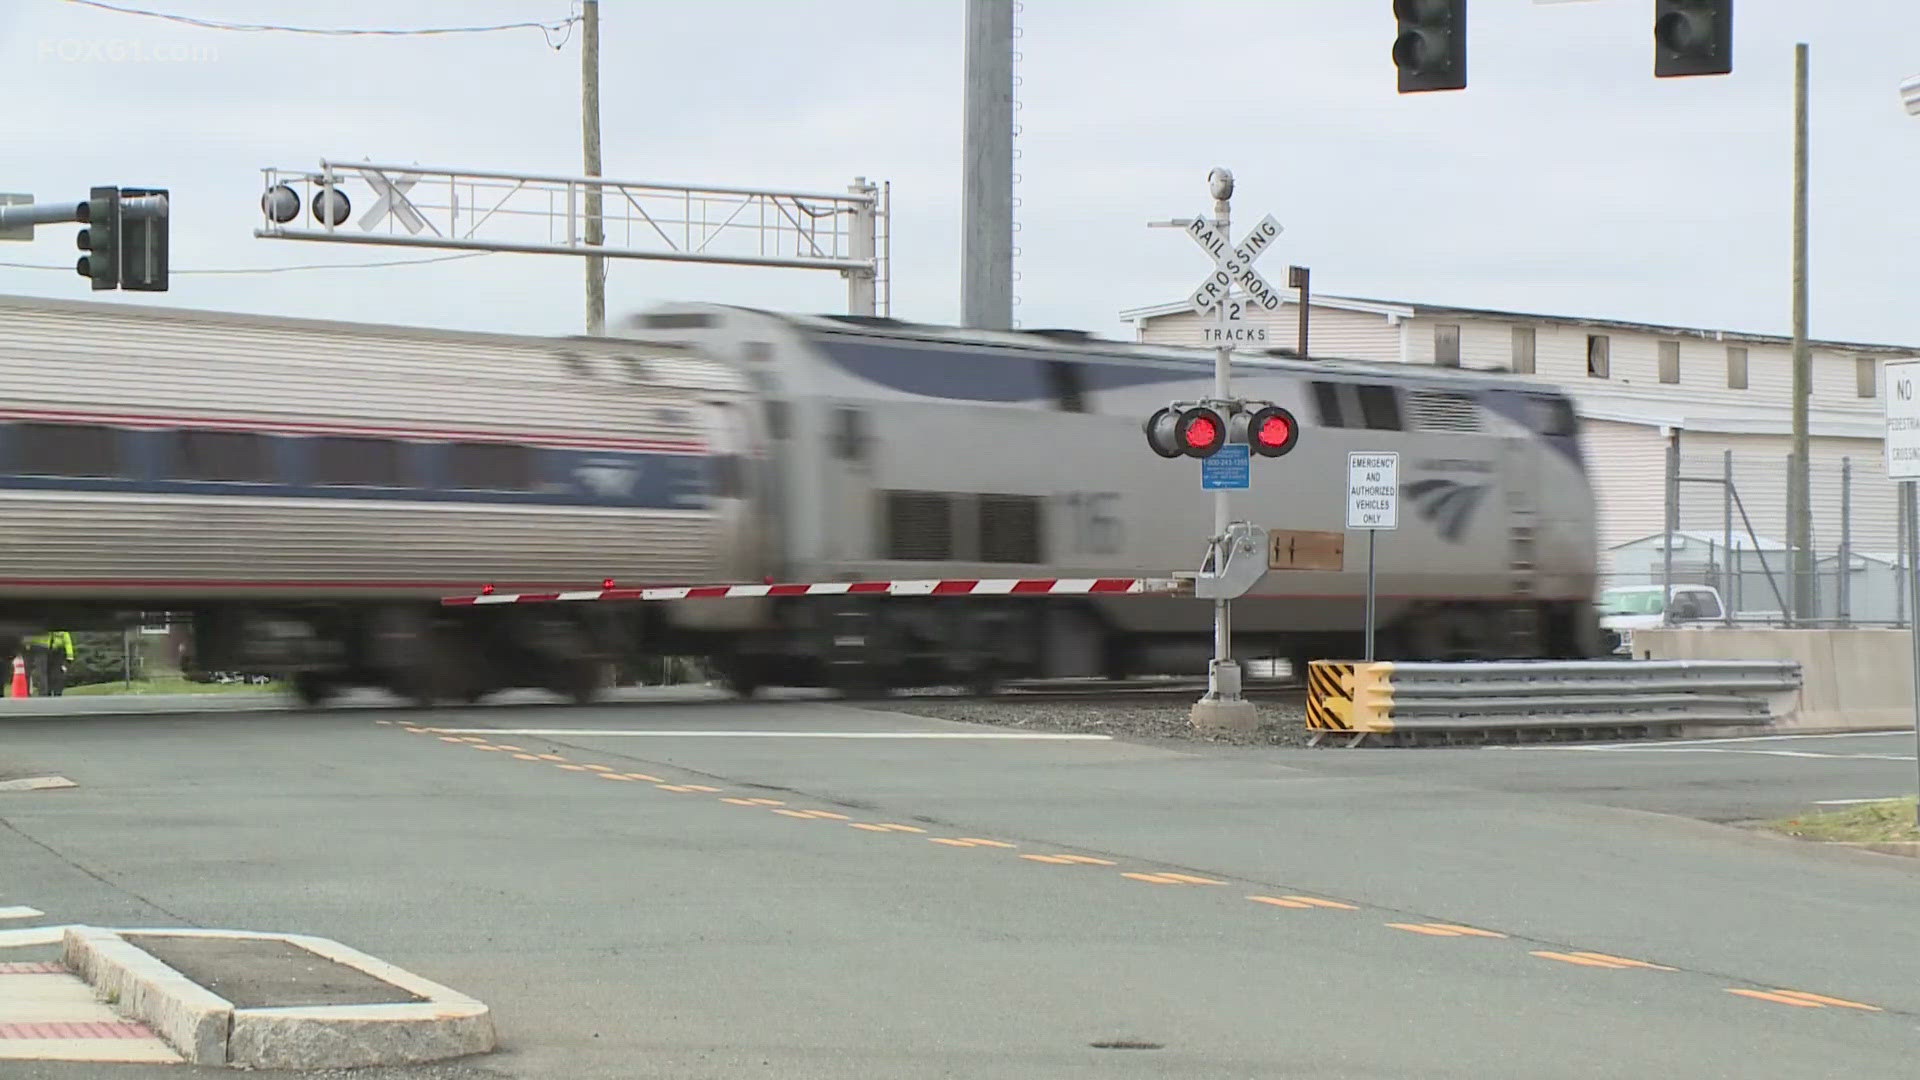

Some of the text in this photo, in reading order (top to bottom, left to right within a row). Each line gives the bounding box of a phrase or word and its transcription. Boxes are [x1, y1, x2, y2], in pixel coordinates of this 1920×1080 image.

[1190, 219, 1278, 310] RAIL ROAD
[1196, 222, 1275, 307] CROSSING
[1229, 303, 1240, 320] 2
[1204, 328, 1265, 341] TRACKS
[1897, 379, 1912, 401] NO
[1887, 418, 1920, 432] PEDESTRIA
[1352, 457, 1395, 469] EMERGENCY
[1365, 472, 1381, 482] AND
[1351, 486, 1395, 497] AUTHORIZED
[1356, 499, 1390, 511] VEHICLES
[1363, 513, 1382, 524] ONLY
